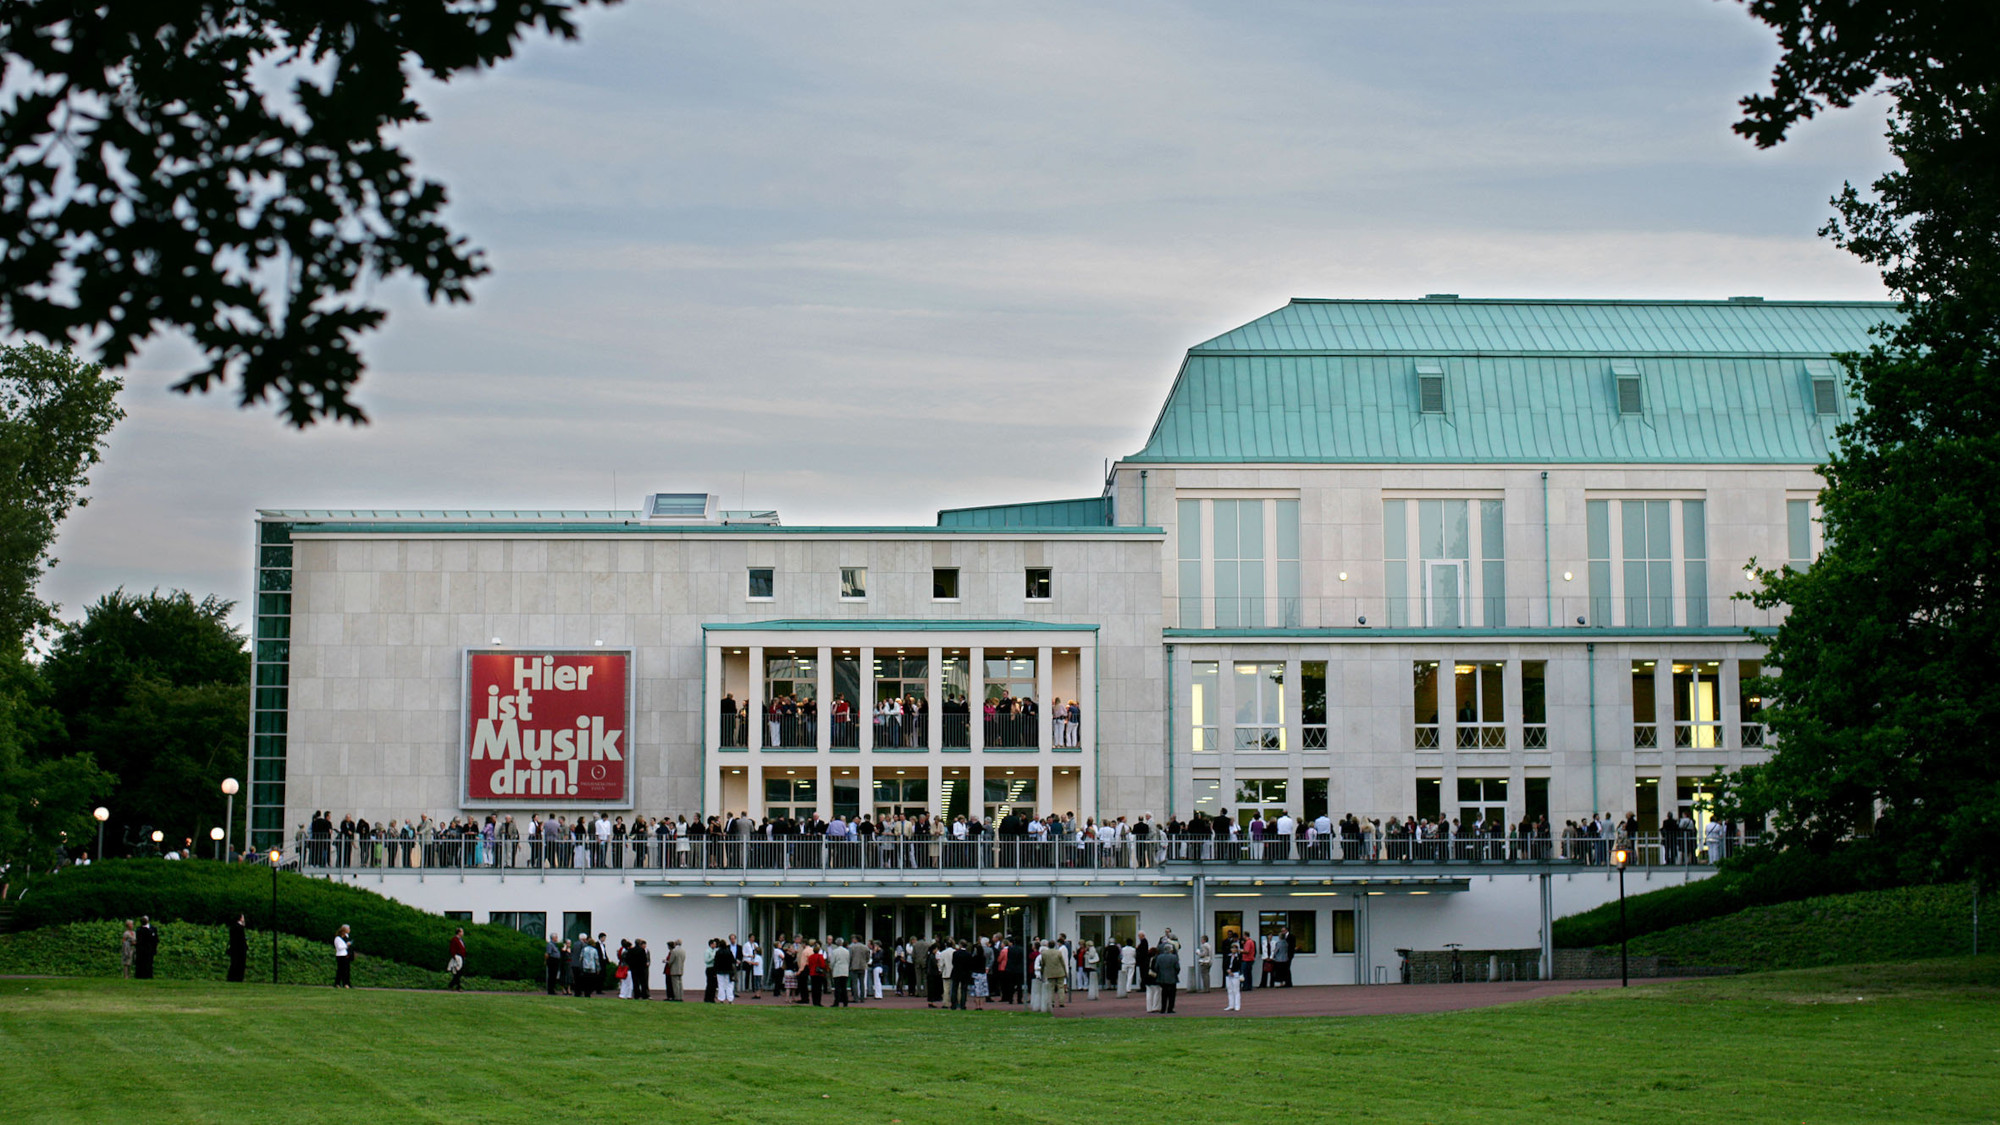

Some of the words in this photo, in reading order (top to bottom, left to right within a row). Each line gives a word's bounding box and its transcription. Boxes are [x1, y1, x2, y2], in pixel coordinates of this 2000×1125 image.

[514, 655, 594, 691] Hier
[488, 685, 533, 721] ist
[471, 715, 623, 761] Musik
[490, 759, 579, 795] drin!
